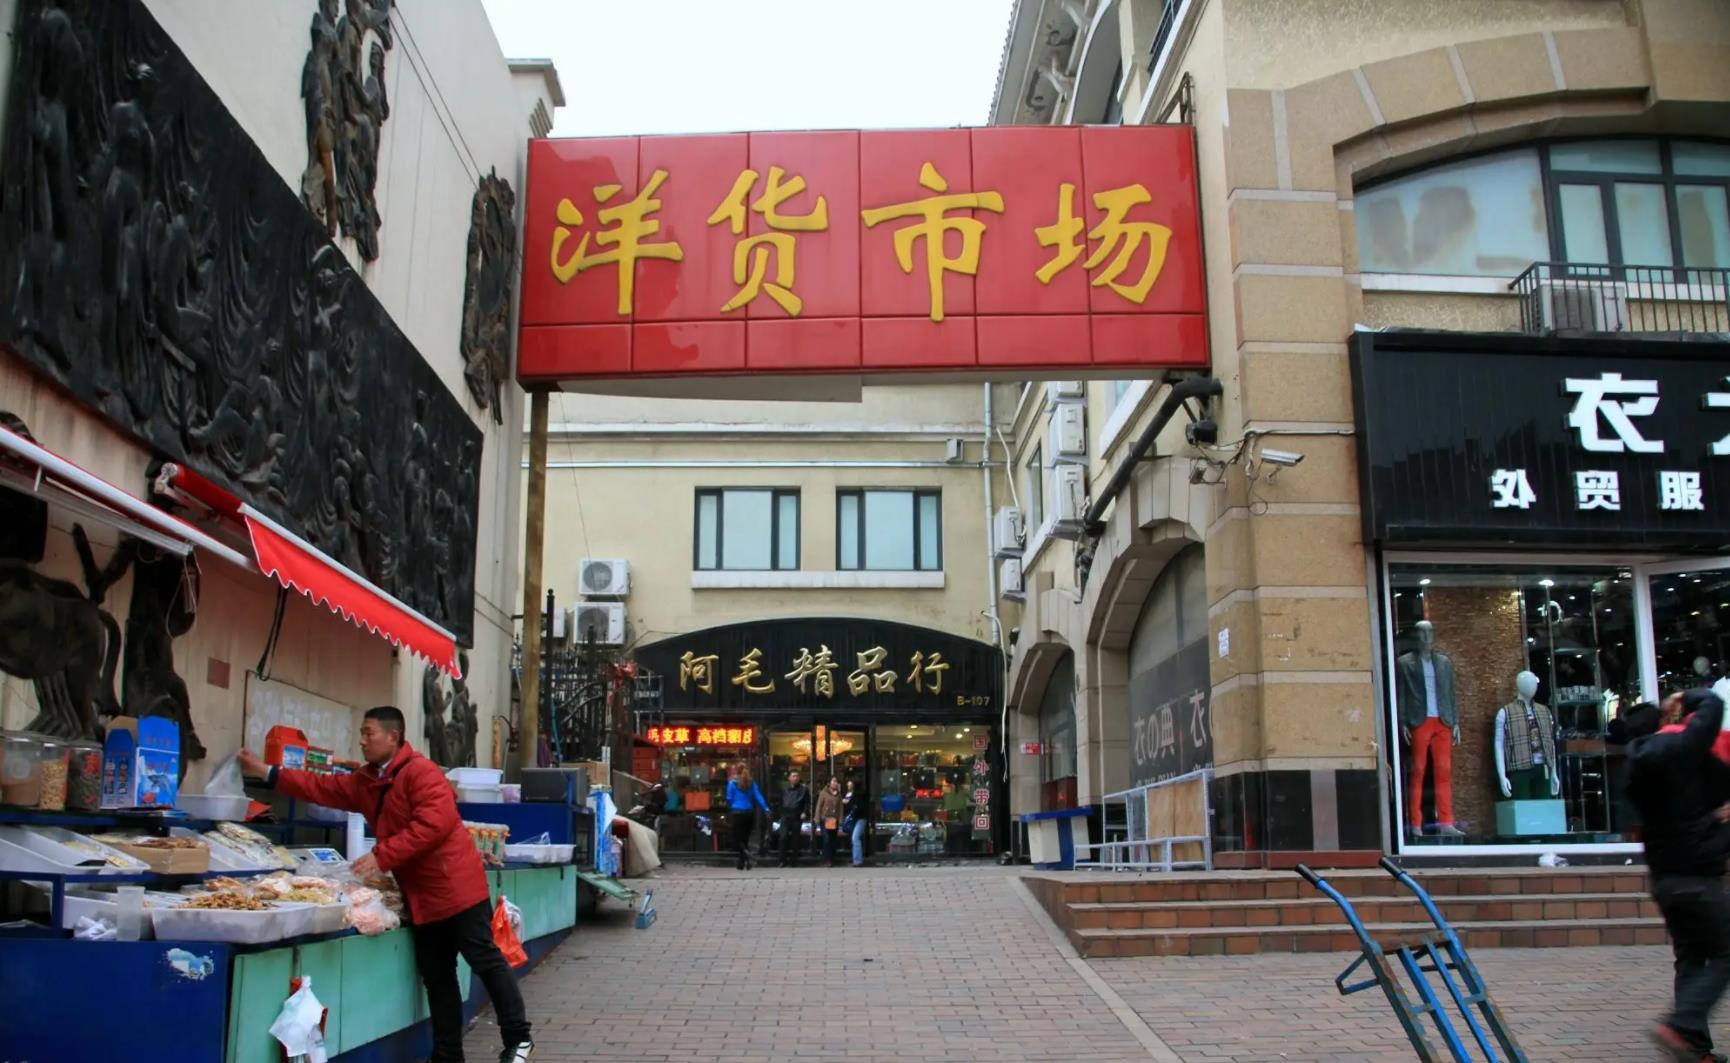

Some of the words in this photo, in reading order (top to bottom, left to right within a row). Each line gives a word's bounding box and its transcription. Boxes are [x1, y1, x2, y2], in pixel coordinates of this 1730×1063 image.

[551, 161, 1173, 322] 洋货市场
[1565, 372, 1730, 459] 衣
[1490, 468, 1705, 511] 外贸服
[679, 645, 950, 699] 阿毛精品行
[956, 695, 991, 706] B-107
